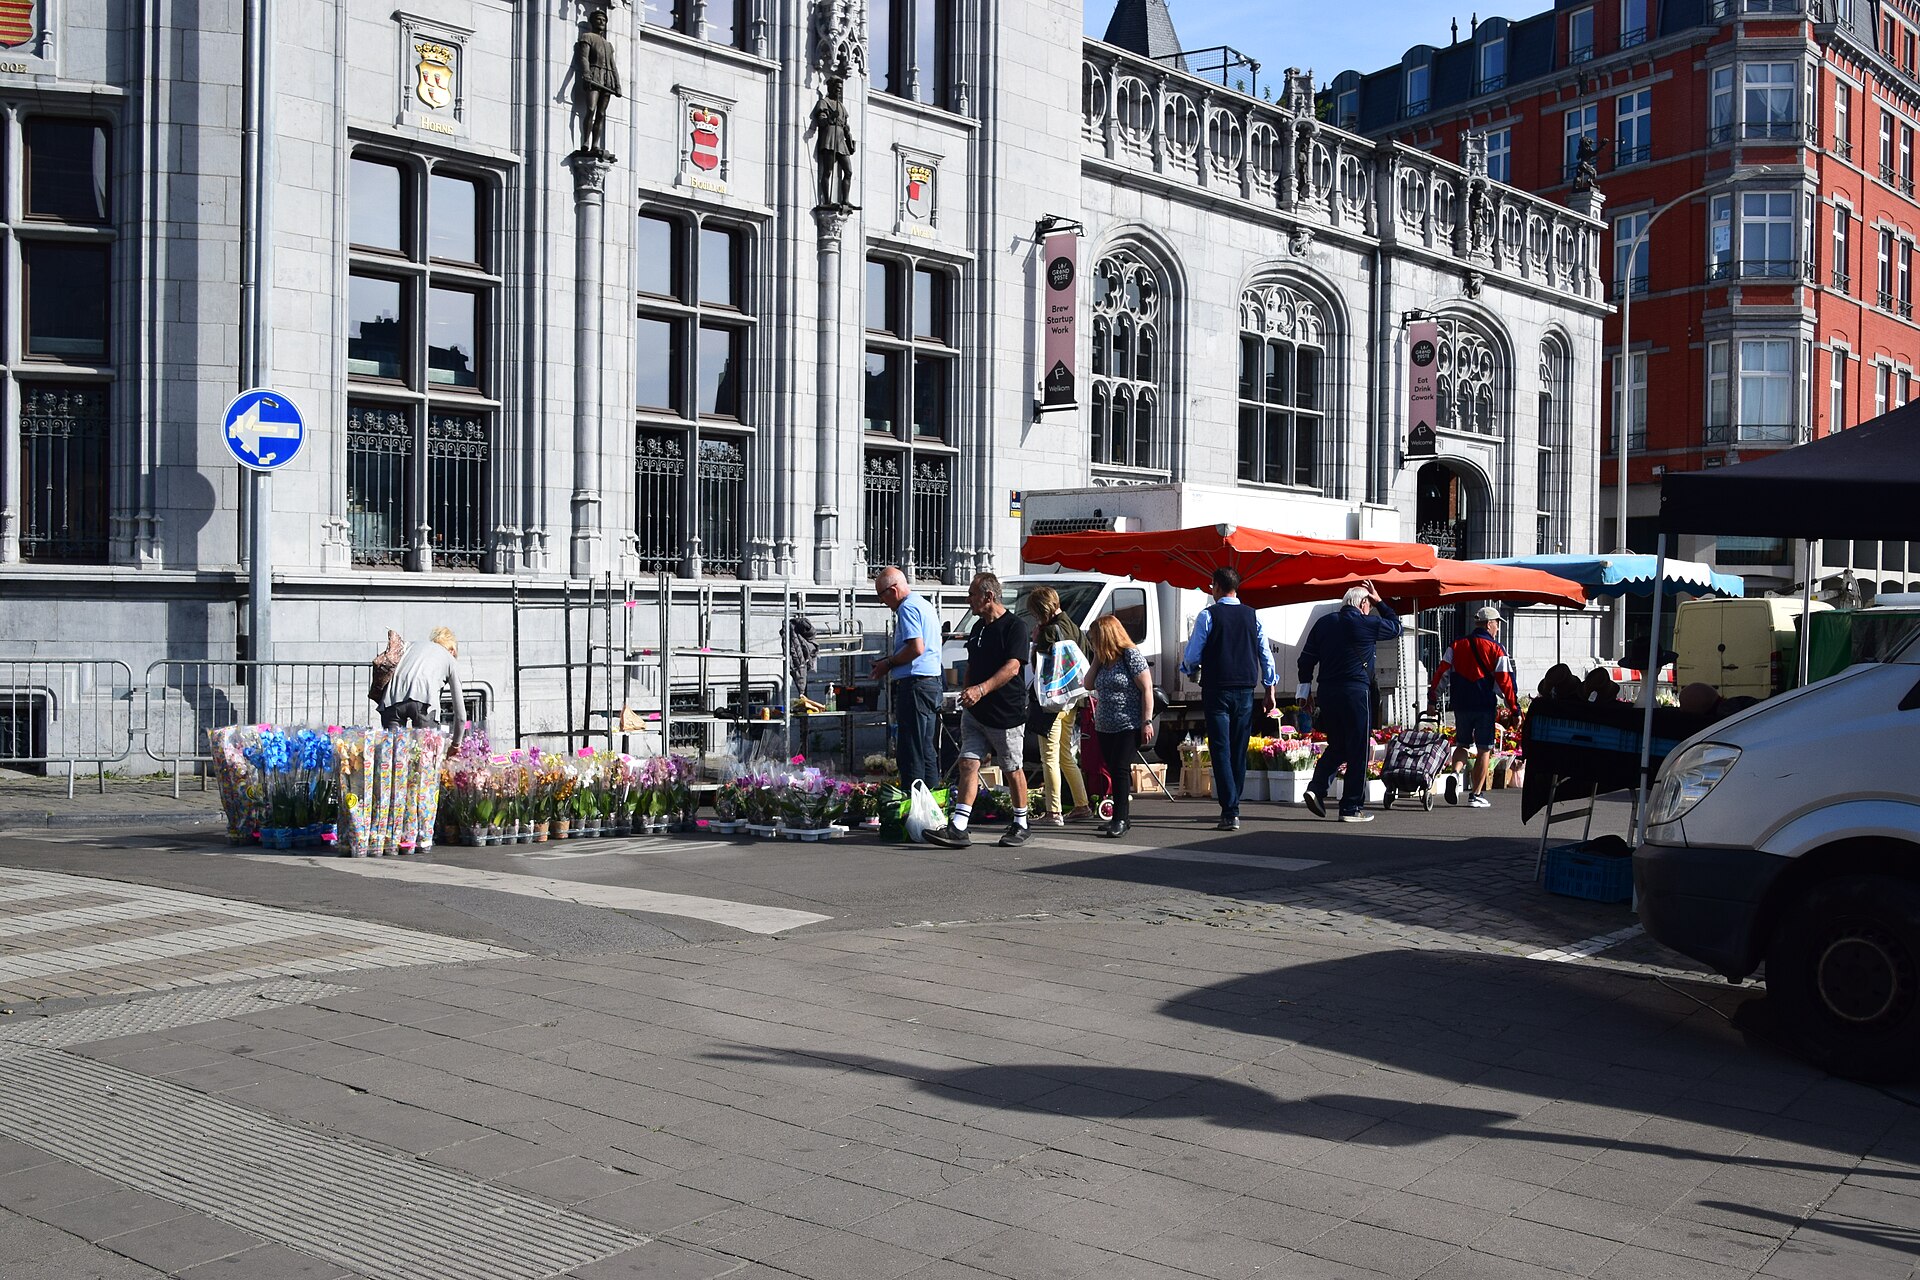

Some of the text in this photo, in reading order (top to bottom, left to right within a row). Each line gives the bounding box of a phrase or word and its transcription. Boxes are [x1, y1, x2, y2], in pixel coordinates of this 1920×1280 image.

[0, 61, 28, 73] OOZ
[1051, 305, 1069, 313] Brew
[1046, 316, 1074, 325] Startup
[1051, 326, 1069, 334] Work
